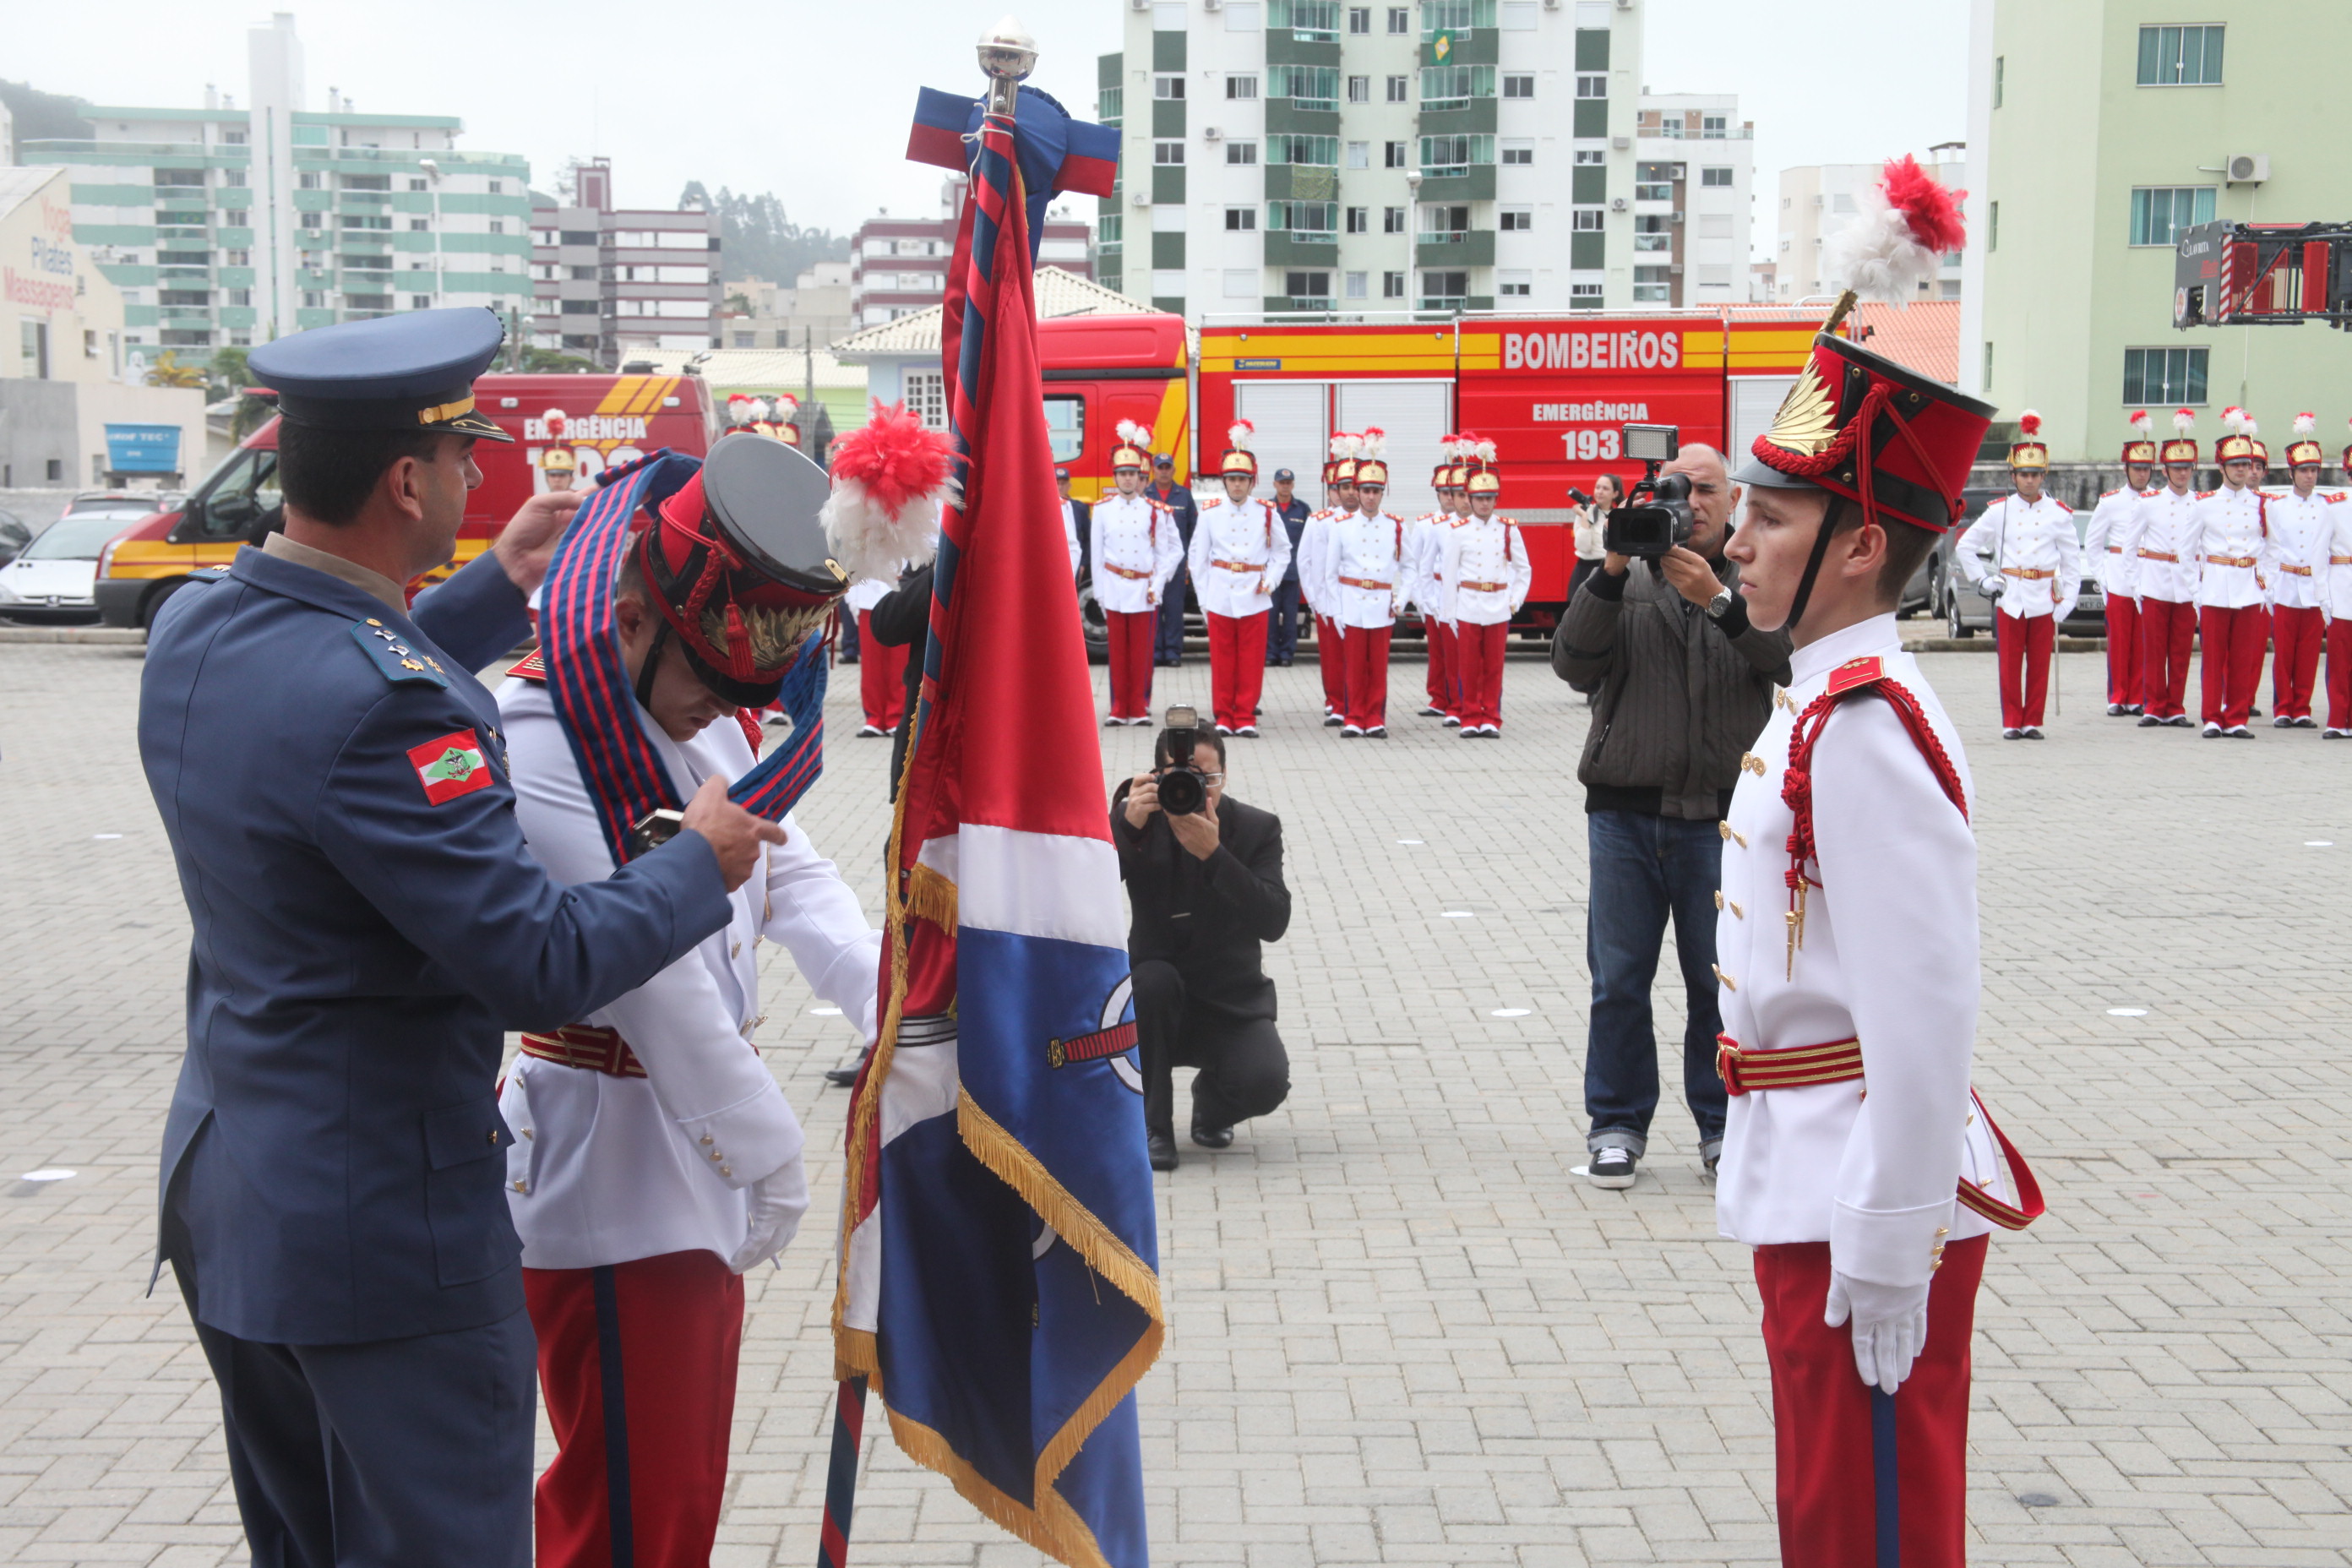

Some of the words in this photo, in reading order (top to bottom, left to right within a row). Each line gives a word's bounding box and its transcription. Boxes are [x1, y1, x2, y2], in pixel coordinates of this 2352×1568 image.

[41, 195, 72, 242] Yoga
[31, 236, 73, 275] Pilates
[3, 265, 74, 316] Massagens
[1505, 332, 1679, 369] BOMBEIROS
[524, 414, 647, 440] EMRGÊNCIA
[1533, 400, 1649, 422] EMERGÊNCIA
[1561, 429, 1620, 460] 193
